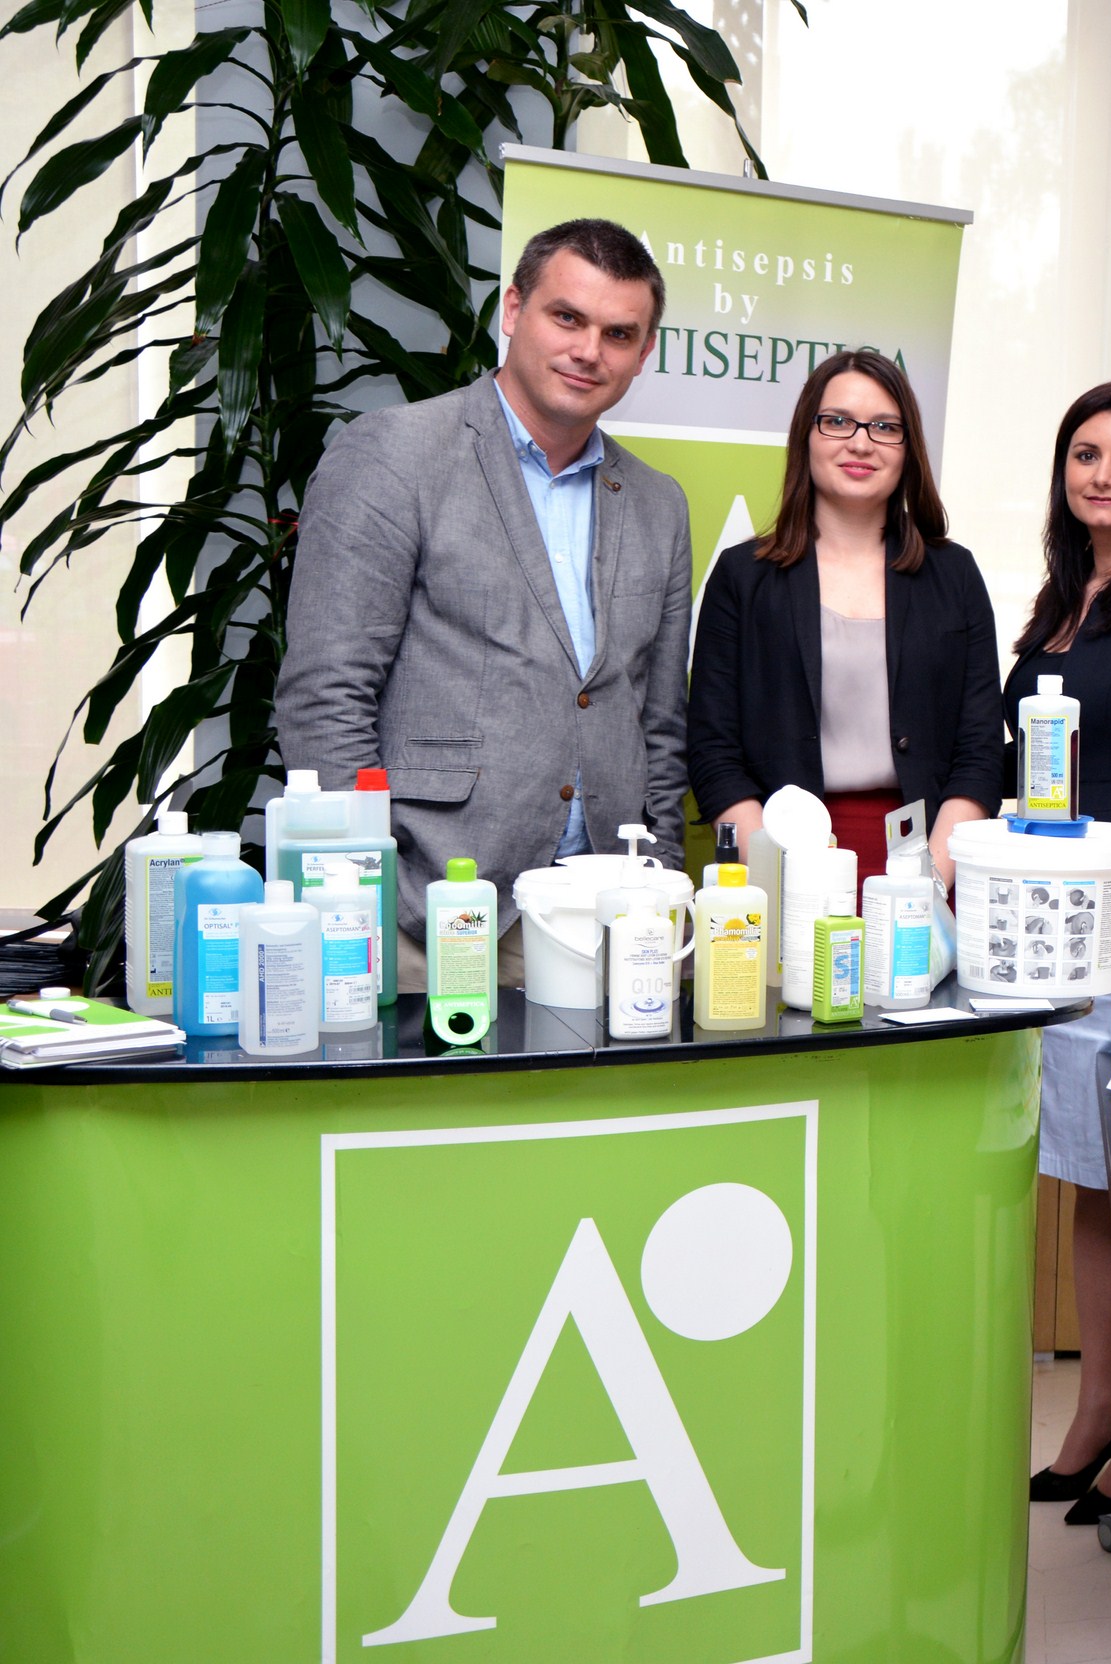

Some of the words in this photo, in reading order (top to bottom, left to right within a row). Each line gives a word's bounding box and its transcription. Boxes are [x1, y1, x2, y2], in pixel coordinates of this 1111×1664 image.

[638, 230, 854, 286] Antisepsis
[713, 283, 760, 325] by
[631, 977, 664, 994] Q10
[362, 1217, 786, 1647] A
